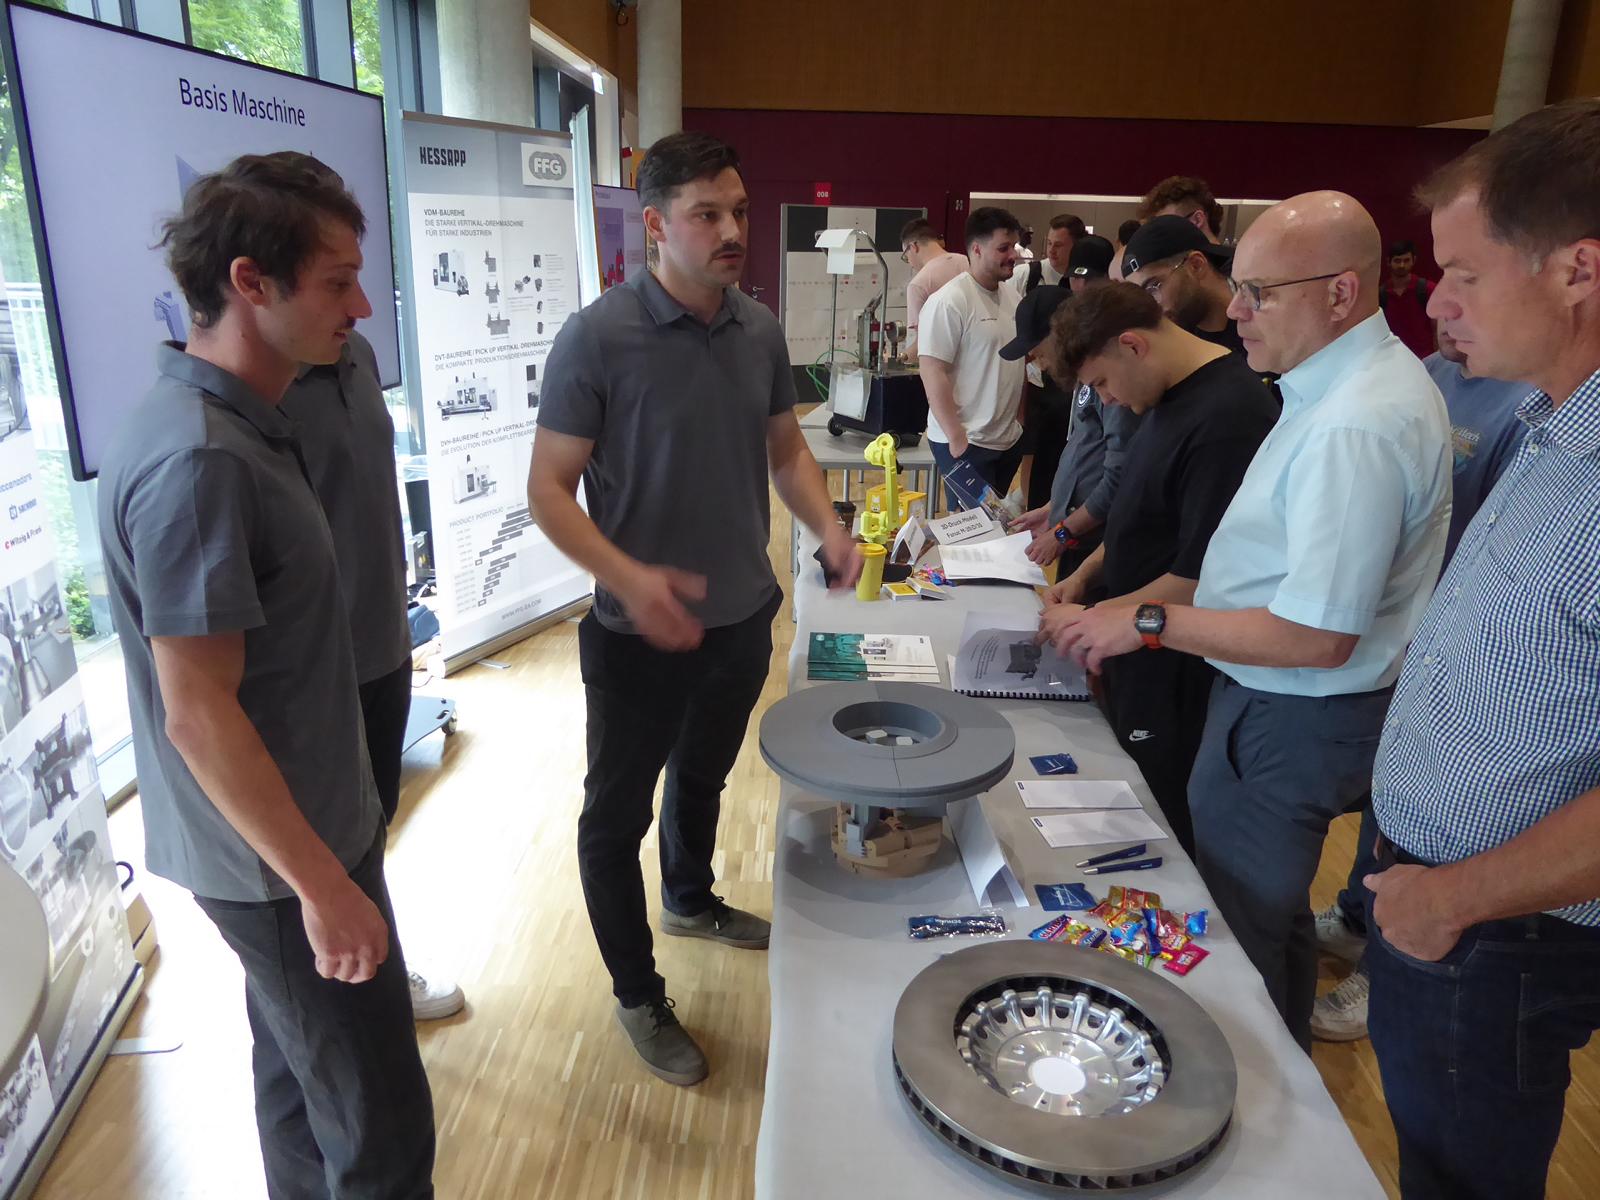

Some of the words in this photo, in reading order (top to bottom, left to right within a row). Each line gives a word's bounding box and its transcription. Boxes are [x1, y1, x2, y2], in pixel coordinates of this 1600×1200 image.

[179, 78, 228, 113] Basis
[232, 89, 306, 127] Maschine
[419, 146, 467, 168] HESSAPP
[533, 157, 562, 175] FFG
[425, 219, 435, 227] DIE
[436, 219, 456, 227] STARKE
[457, 219, 524, 227] VERTIKAL-DREHMASCHINE
[425, 228, 438, 236] FÜR
[434, 349, 473, 362] DVT-BAUREIHE
[482, 429, 495, 437] PICK
[450, 440, 480, 454] EVOLUTION
[449, 514, 474, 529] PRODUCT
[476, 506, 503, 521] PORTFOLIO
